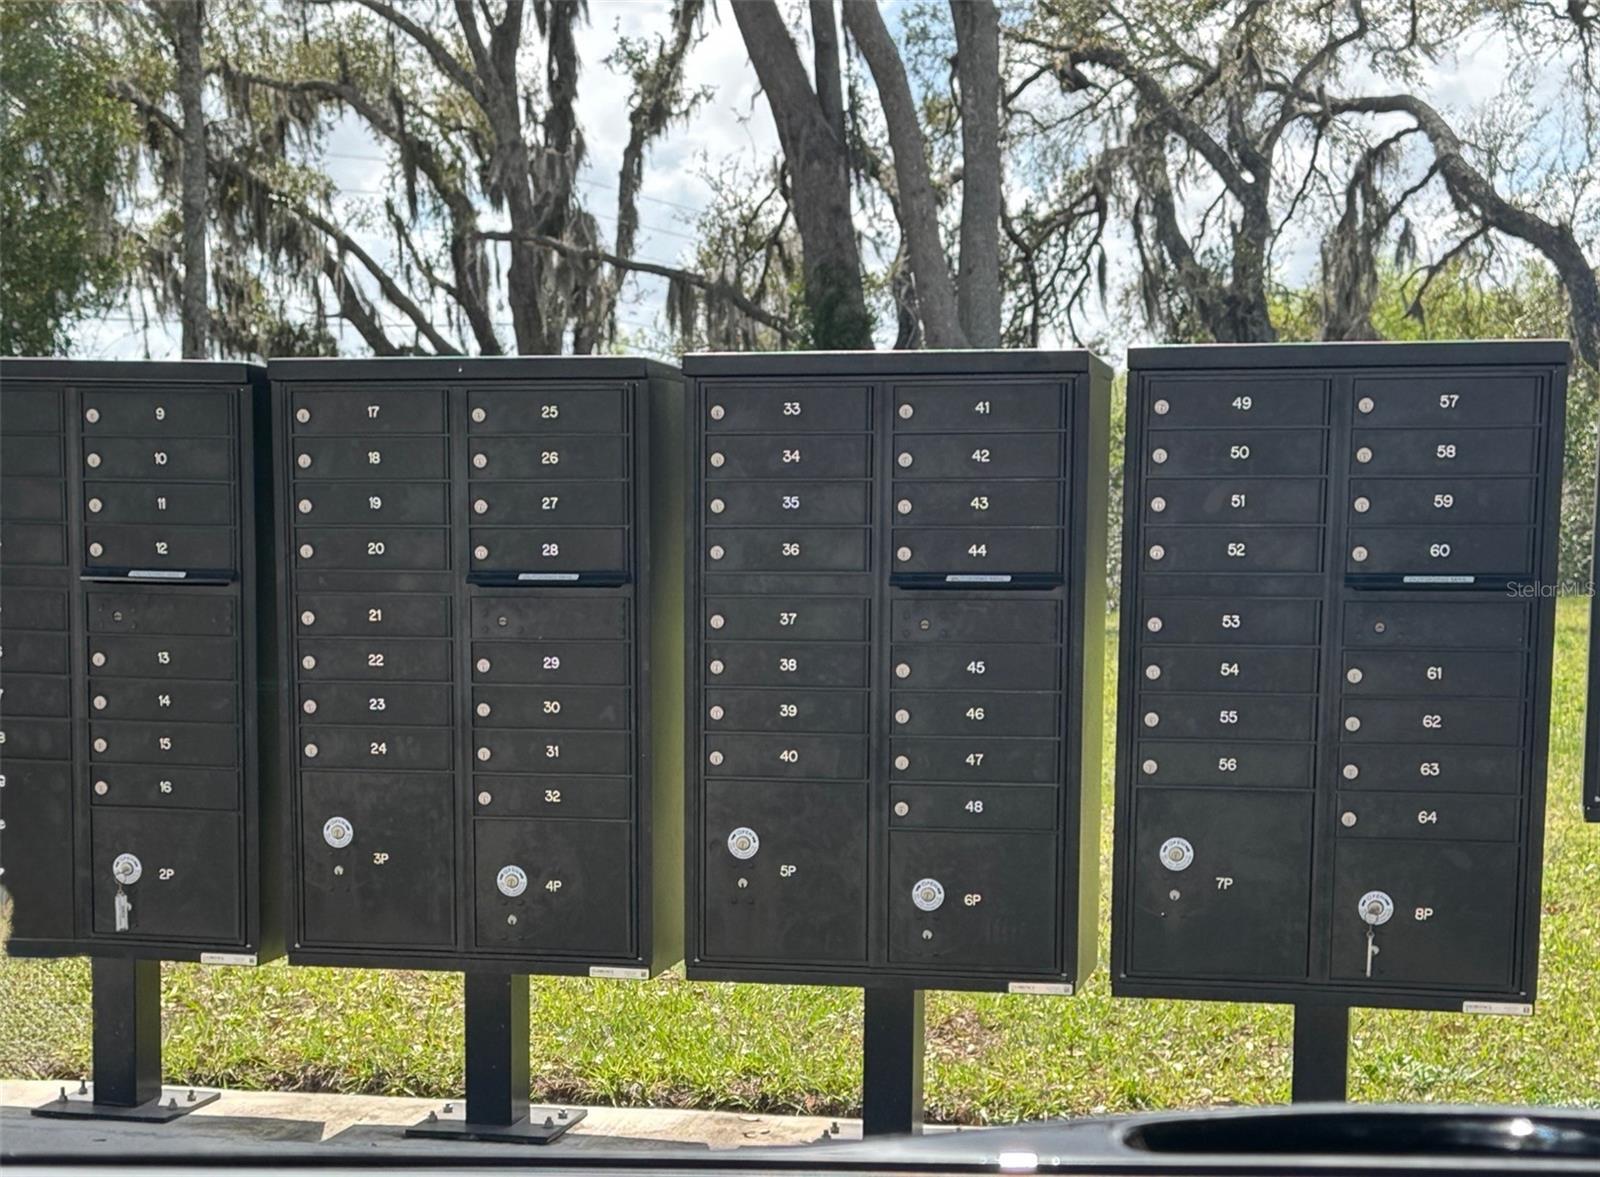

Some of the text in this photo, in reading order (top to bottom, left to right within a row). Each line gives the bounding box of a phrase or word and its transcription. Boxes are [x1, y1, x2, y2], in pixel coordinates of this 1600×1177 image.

[974, 401, 990, 414] 41
[1231, 396, 1252, 410] 49
[1439, 394, 1460, 409] 57
[155, 407, 165, 421] 9
[367, 405, 380, 418] 17
[541, 405, 559, 419] 25
[783, 402, 801, 416] 33
[154, 452, 168, 465] 10
[367, 451, 381, 465] 18
[541, 451, 559, 465] 26
[782, 449, 801, 463] 34
[971, 448, 991, 463] 42
[1230, 445, 1250, 460] 50
[1436, 444, 1457, 459] 58
[157, 497, 166, 510] 11
[368, 496, 382, 510] 19
[541, 496, 559, 510] 27
[782, 495, 800, 509] 35
[970, 496, 989, 510] 43
[1231, 494, 1246, 508] 51
[1433, 494, 1454, 508] 59
[155, 541, 168, 555] 12
[367, 542, 385, 555] 20
[541, 543, 559, 557] 28
[782, 543, 800, 556] 36
[967, 544, 987, 557] 44
[1227, 542, 1246, 557] 52
[1429, 543, 1451, 558] 60
[368, 608, 382, 622] 21
[779, 612, 797, 626] 37
[1221, 614, 1241, 629] 53
[157, 651, 170, 664] 13
[368, 653, 385, 667] 22
[543, 656, 560, 670] 29
[779, 658, 797, 672] 38
[966, 661, 986, 674] 45
[1220, 662, 1240, 676] 54
[1426, 666, 1442, 680] 61
[158, 694, 171, 707] 14
[369, 697, 386, 711] 23
[543, 700, 561, 714] 30
[779, 704, 798, 718] 39
[965, 707, 985, 721] 46
[1219, 710, 1238, 724] 55
[1422, 714, 1442, 729] 62
[159, 737, 172, 750] 15
[370, 742, 388, 755] 24
[545, 745, 559, 758] 31
[779, 749, 799, 763] 40
[965, 753, 984, 766] 47
[1218, 757, 1237, 772] 56
[1420, 762, 1440, 776] 63
[159, 780, 173, 794] 16
[544, 789, 561, 803] 32
[964, 800, 984, 813] 48
[1417, 810, 1438, 824] 64
[373, 852, 390, 865] 3P
[158, 868, 175, 880] 2P
[779, 864, 797, 878] 5P
[545, 879, 562, 892] 4P
[1215, 876, 1234, 890] 7P
[963, 893, 982, 907] 6P
[1414, 907, 1434, 921] 8P
